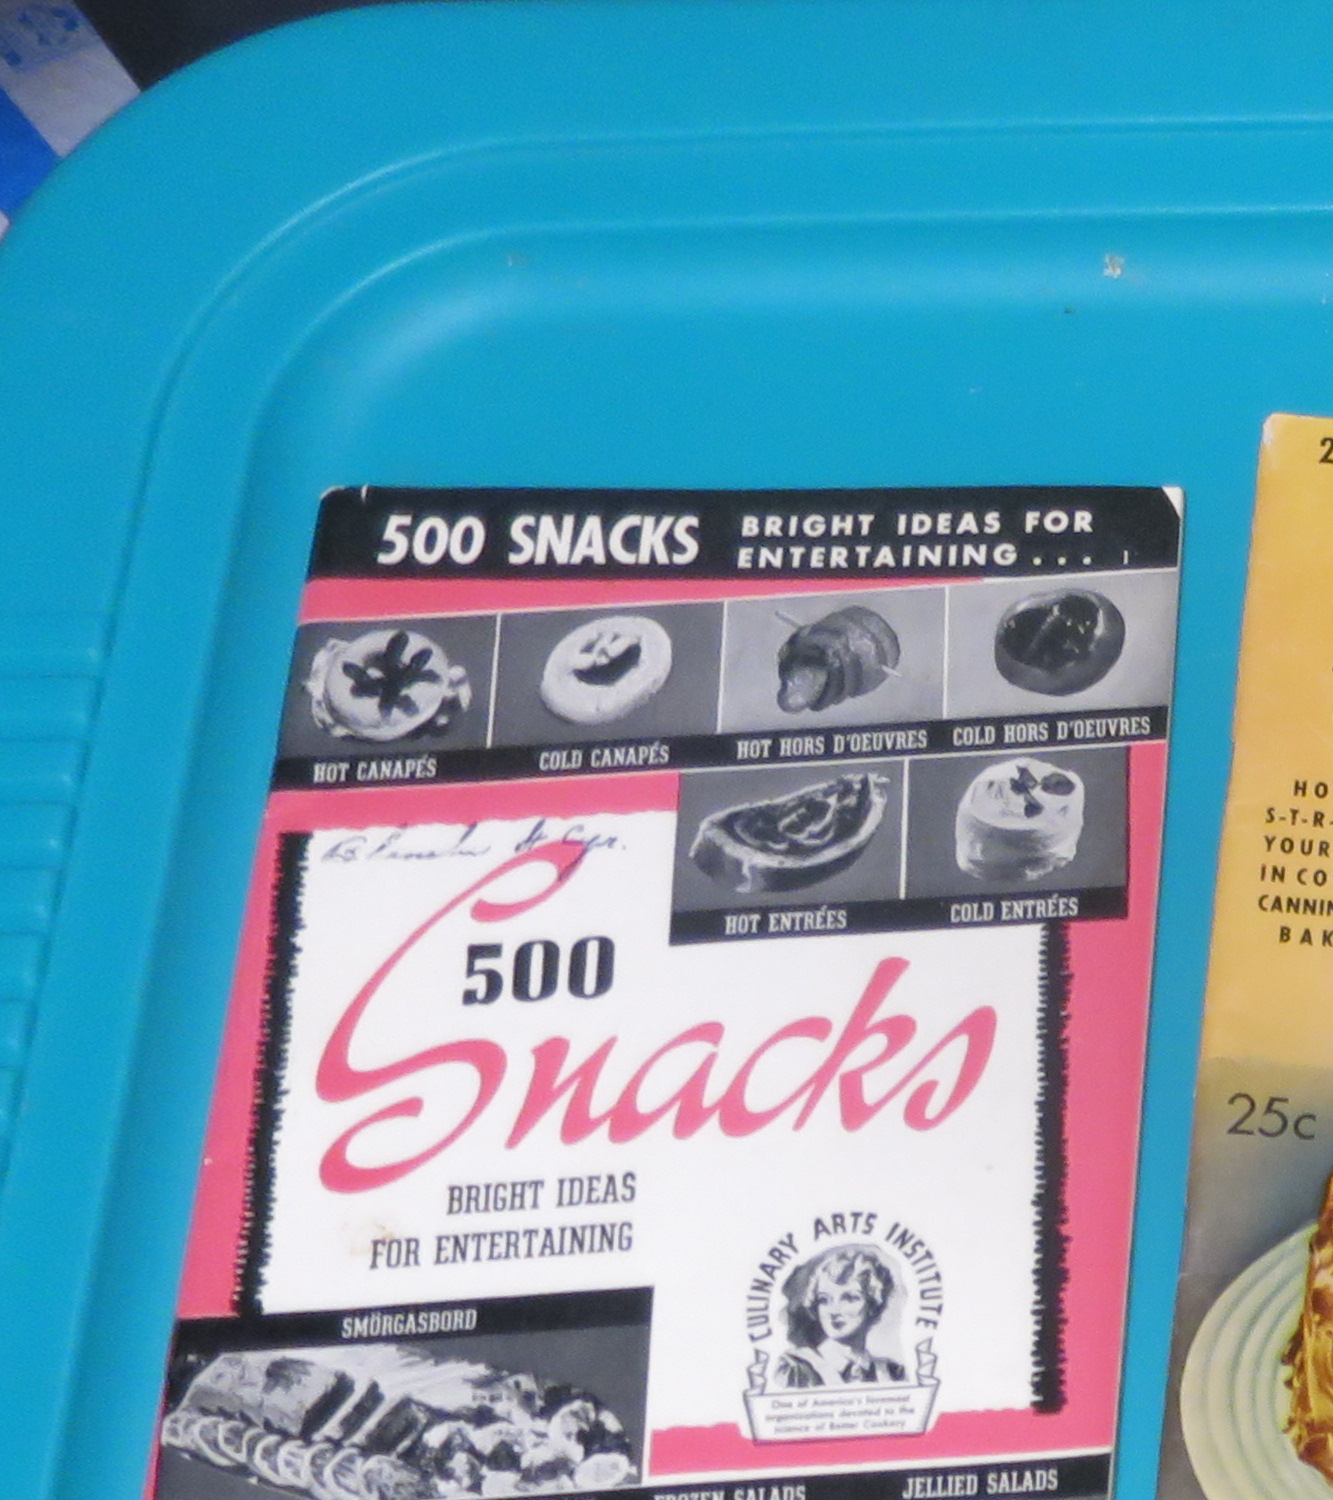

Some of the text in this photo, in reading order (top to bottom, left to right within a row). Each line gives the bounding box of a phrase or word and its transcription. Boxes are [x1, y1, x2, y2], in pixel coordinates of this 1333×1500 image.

[377, 513, 700, 566] 500 SNACKS
[740, 509, 1094, 538] BRIGHT IDEAS FOR
[736, 729, 928, 760] HOT HORS D'OEUVRES
[952, 715, 1152, 748] COLD HORS D'OEUVRES
[313, 753, 438, 784] HOT CANAPÉS
[538, 740, 671, 772] COLD CANAPÉS
[1262, 834, 1332, 859] YOUR
[1259, 863, 1287, 885] IN
[723, 905, 848, 936] HOT ENTRÉES
[950, 893, 1079, 923] COLD ENTRÉES
[462, 935, 616, 1007] 500
[315, 839, 997, 1194] Snacks
[1226, 1091, 1318, 1142] 25c
[446, 1172, 637, 1215] BRIGHT IDEAS
[369, 1221, 634, 1271] FOR ENTERTAINING
[746, 1211, 944, 1343] CULINARY ARTS INSTITUTE
[340, 1307, 478, 1339] SMÖRGASBORD
[902, 1467, 1059, 1500] JELLIED SALADS
